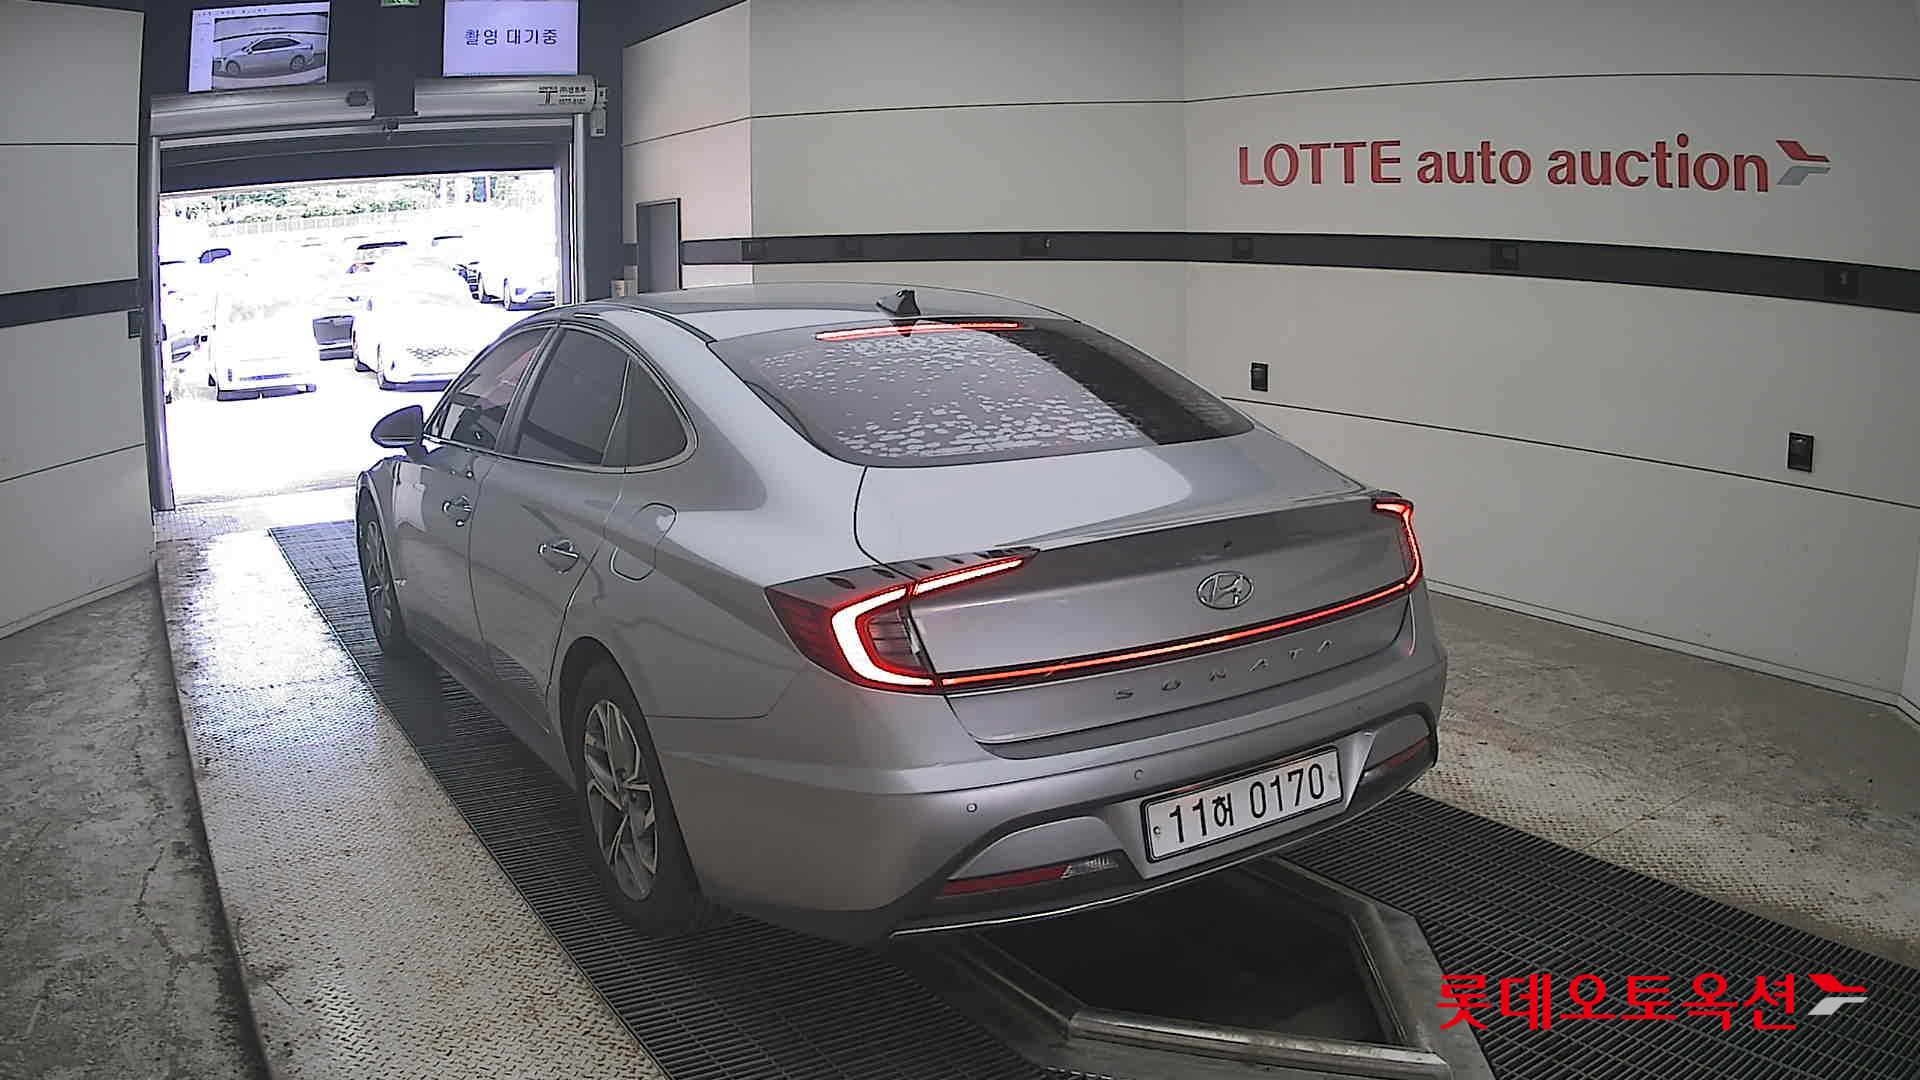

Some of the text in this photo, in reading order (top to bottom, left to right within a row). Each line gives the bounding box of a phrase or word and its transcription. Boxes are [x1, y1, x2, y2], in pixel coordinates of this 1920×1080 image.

[465, 28, 558, 46] 촬영 대기중
[1239, 133, 1770, 192] LOTTE auto auction
[1113, 639, 1333, 700] SONATA
[1168, 763, 1325, 844] 11허 0170
